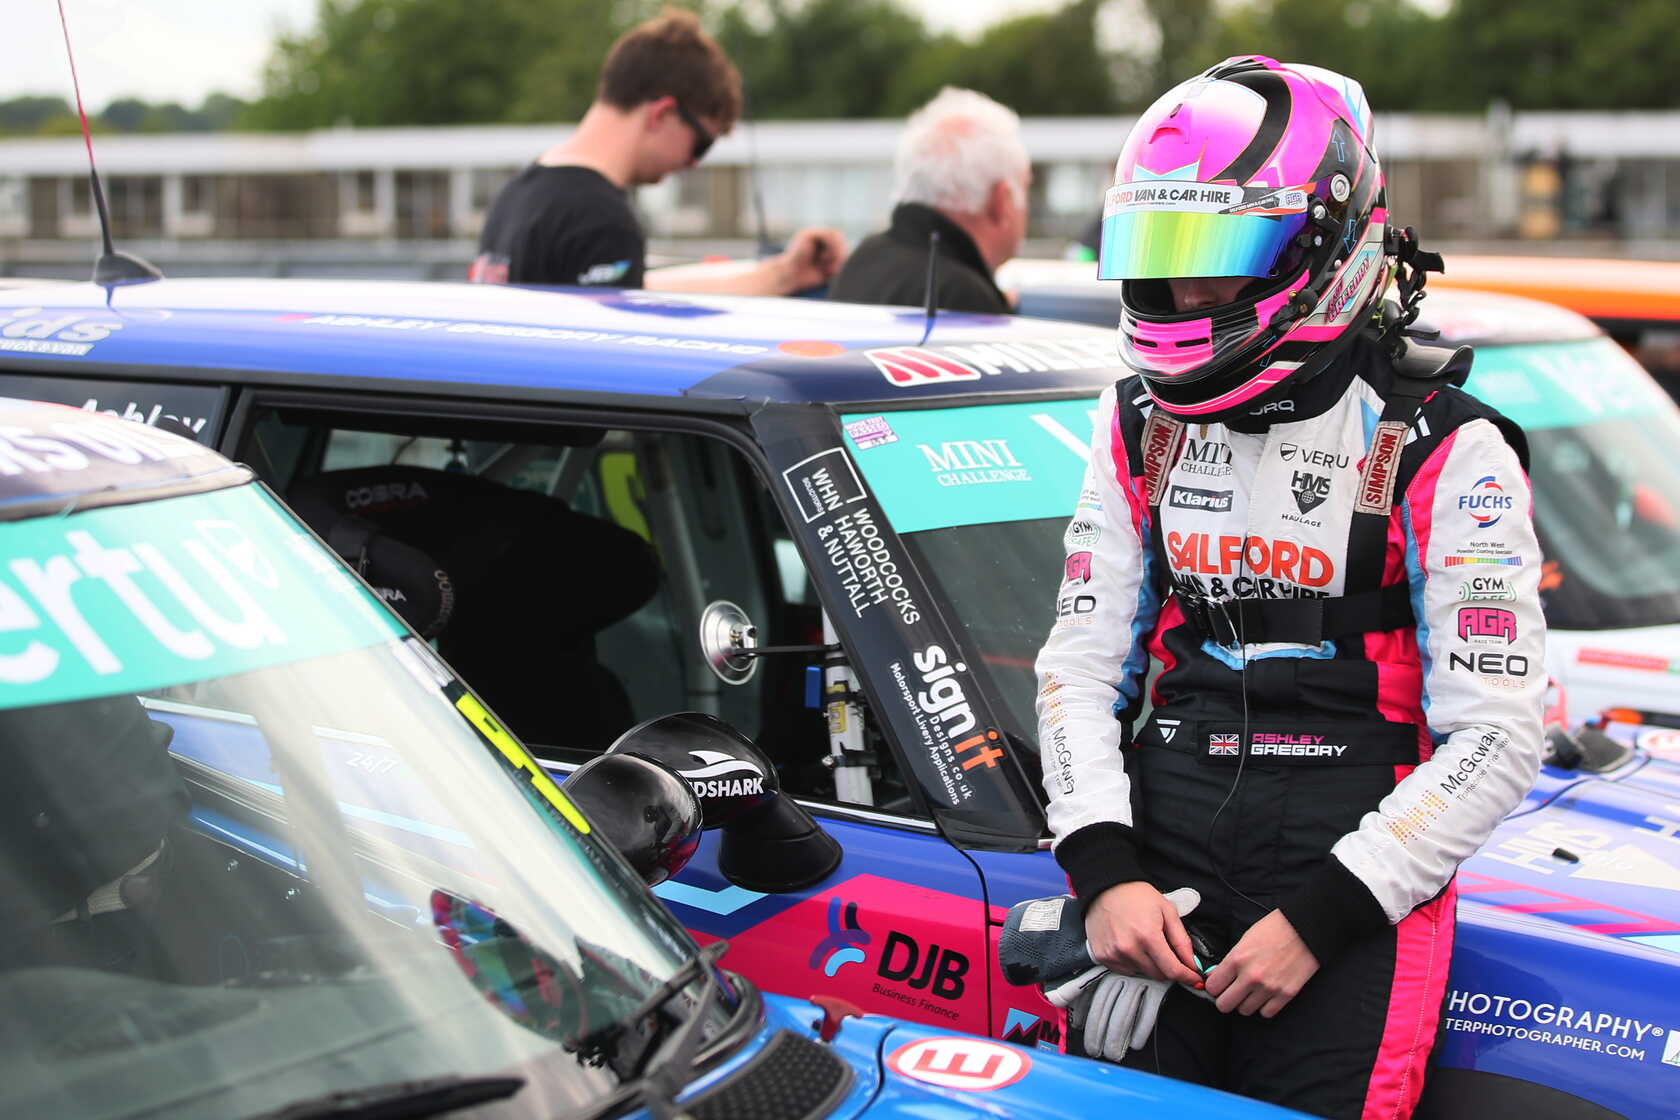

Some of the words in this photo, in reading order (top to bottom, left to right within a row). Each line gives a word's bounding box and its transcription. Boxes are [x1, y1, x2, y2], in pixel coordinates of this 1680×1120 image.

[1135, 189, 1156, 201] VAN
[1158, 188, 1167, 200] &
[1170, 189, 1197, 201] CAR
[1200, 190, 1231, 203] HIRE
[917, 439, 1023, 472] MINI
[1145, 423, 1174, 498] SIMPSON
[936, 468, 1032, 487] CHALLENGE
[1365, 432, 1398, 505] SIMPSON
[812, 467, 843, 511] WHN
[1291, 470, 1331, 495] HMS
[345, 481, 429, 510] COBRA
[1173, 489, 1229, 509] Klarius
[1458, 495, 1513, 510] FUCHS
[817, 524, 834, 541] &
[1073, 521, 1093, 533] GYM
[1281, 513, 1322, 528] HAULAGE
[834, 514, 889, 605] HAWORTH
[853, 507, 921, 625] WOODCOCKS
[1167, 531, 1335, 588] SALFORD
[824, 537, 871, 618] NUTTALL
[1211, 577, 1229, 598] &
[1473, 577, 1505, 590] GYM
[1458, 607, 1517, 645] AGR
[1449, 652, 1529, 677] NEO
[1482, 677, 1527, 689] TOOLS
[890, 662, 922, 716] Motorsport
[915, 714, 934, 746] Livery
[930, 745, 961, 806] Applications
[1252, 733, 1325, 744] ASHLEY
[1251, 744, 1347, 756] GREGORY
[345, 751, 400, 775] 24/7
[689, 777, 764, 798] DSHARK
[877, 930, 970, 1000] DJB
[873, 983, 917, 1007] Business
[918, 999, 960, 1021] Finance
[1448, 990, 1664, 1042] HOTOGRAPHY®
